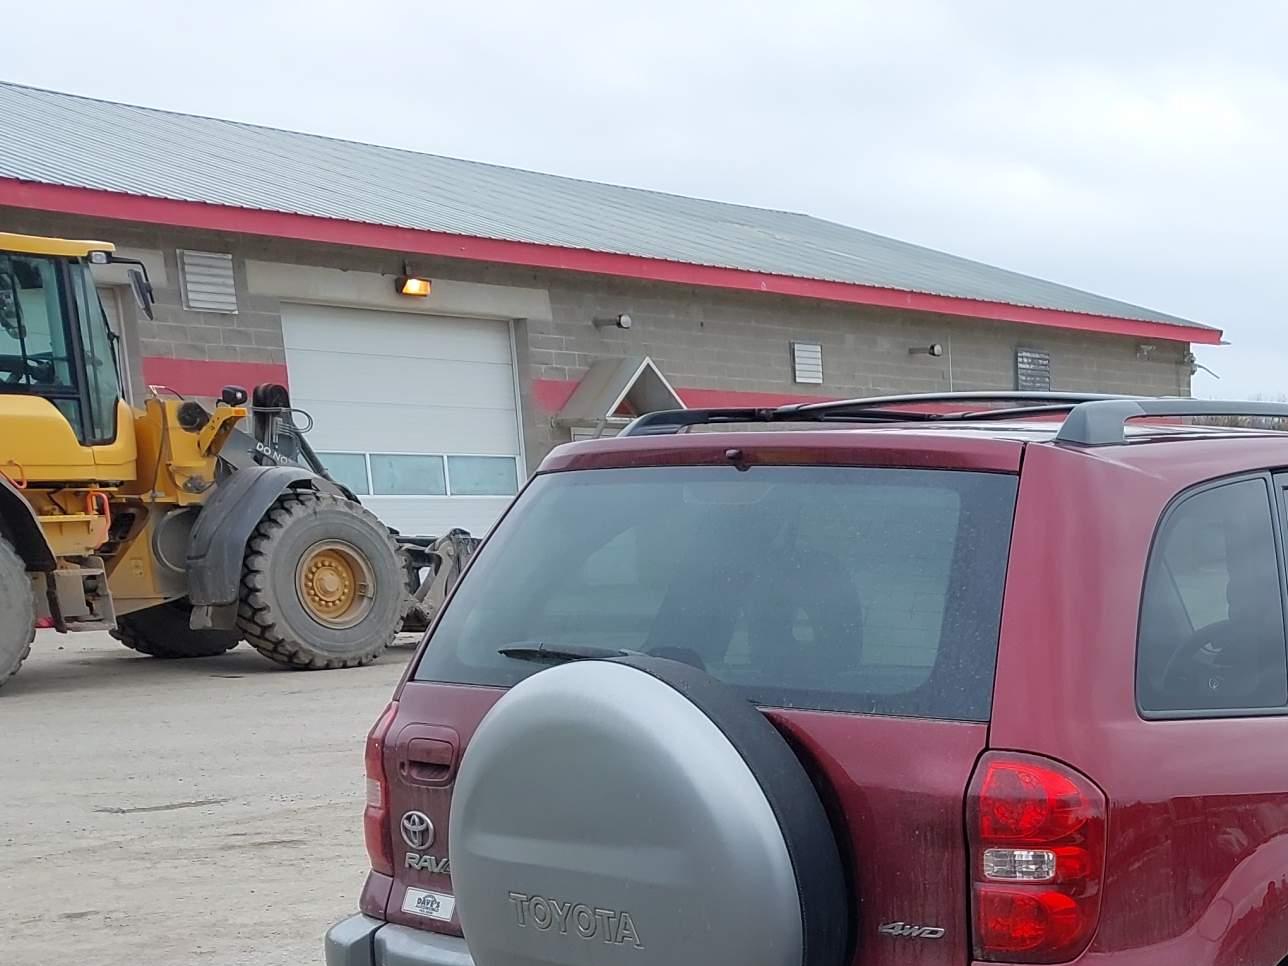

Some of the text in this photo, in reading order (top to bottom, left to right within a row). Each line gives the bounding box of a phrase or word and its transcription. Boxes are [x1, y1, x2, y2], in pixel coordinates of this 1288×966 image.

[256, 441, 290, 464] DO NO
[508, 891, 645, 950] TOYOTA
[878, 921, 945, 938] 4WD
